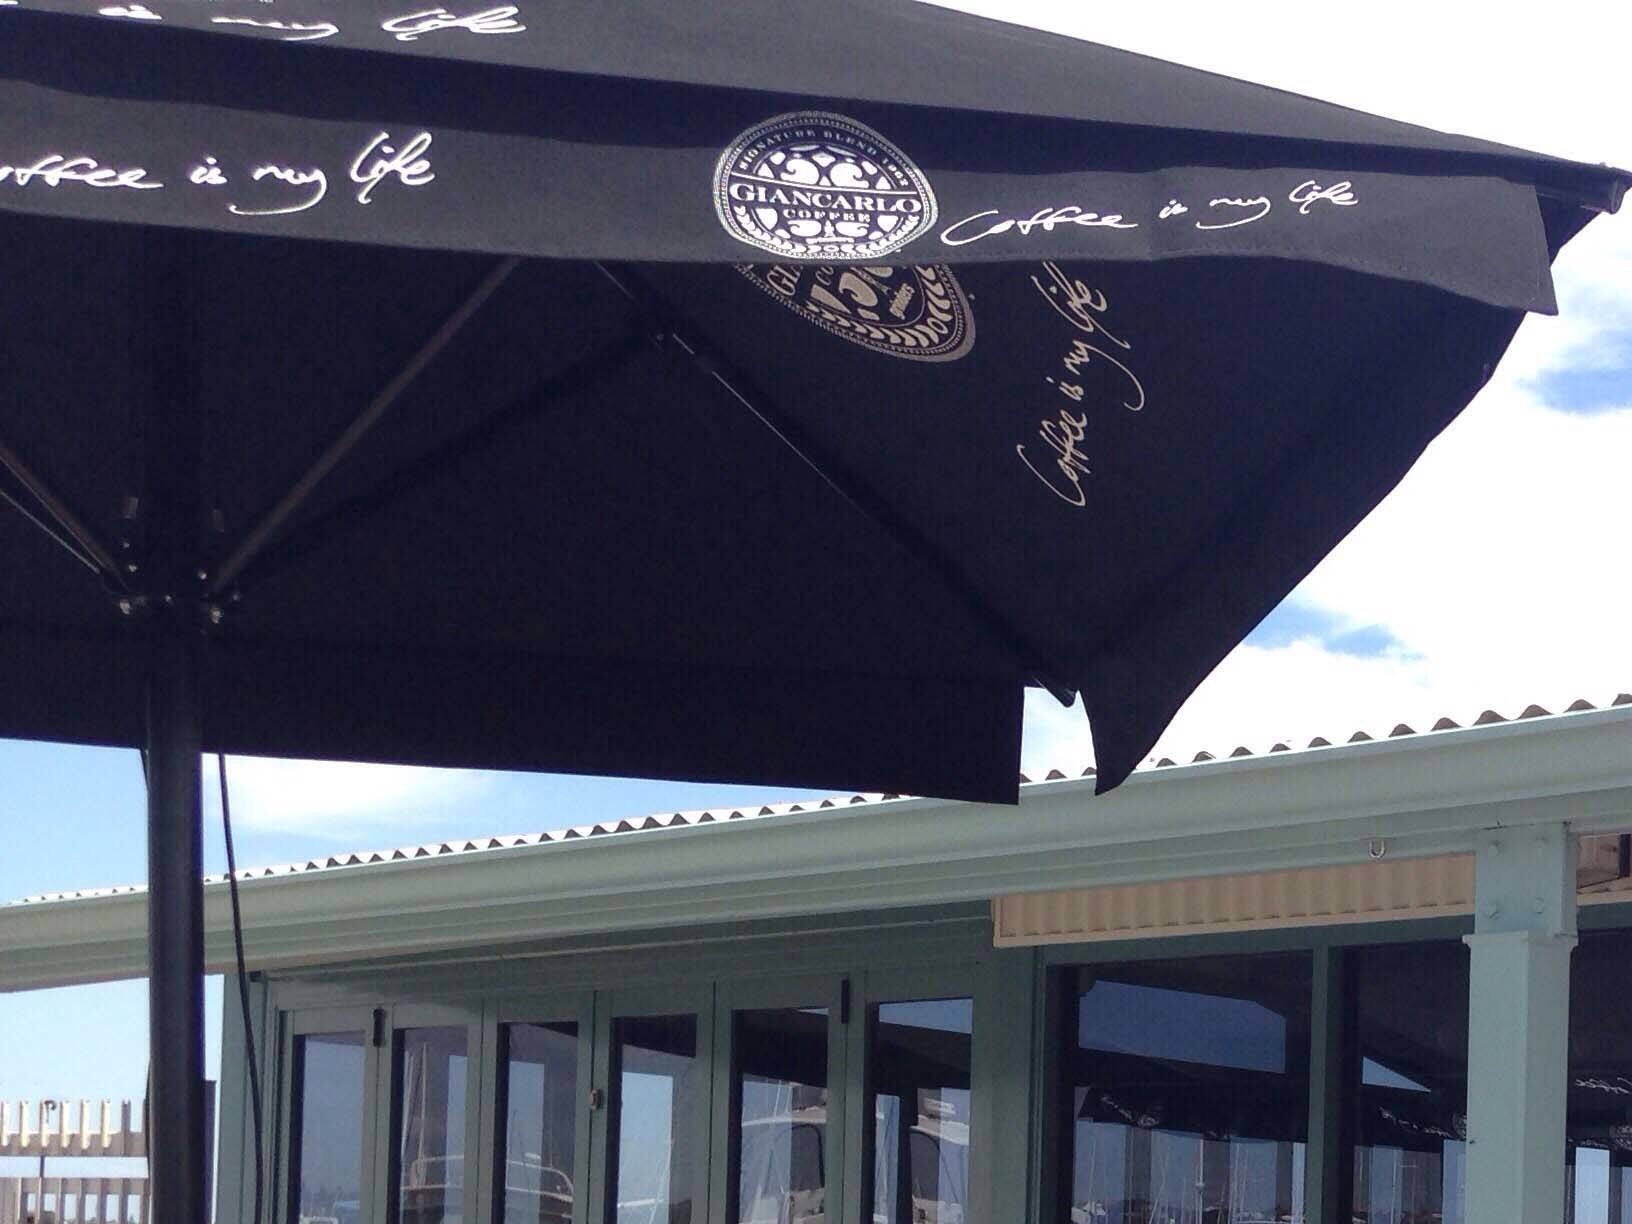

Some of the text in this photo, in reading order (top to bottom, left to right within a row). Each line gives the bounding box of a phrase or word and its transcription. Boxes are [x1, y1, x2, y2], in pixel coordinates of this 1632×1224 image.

[189, 156, 228, 185] is
[229, 165, 327, 216] my
[349, 131, 436, 205] life
[728, 183, 922, 213] GIANCARLO
[782, 208, 871, 224] COFFEE
[940, 179, 1359, 246] Coffee is my life
[1045, 376, 1085, 401] is
[1063, 339, 1145, 412] my
[1016, 409, 1091, 506] Coffee
